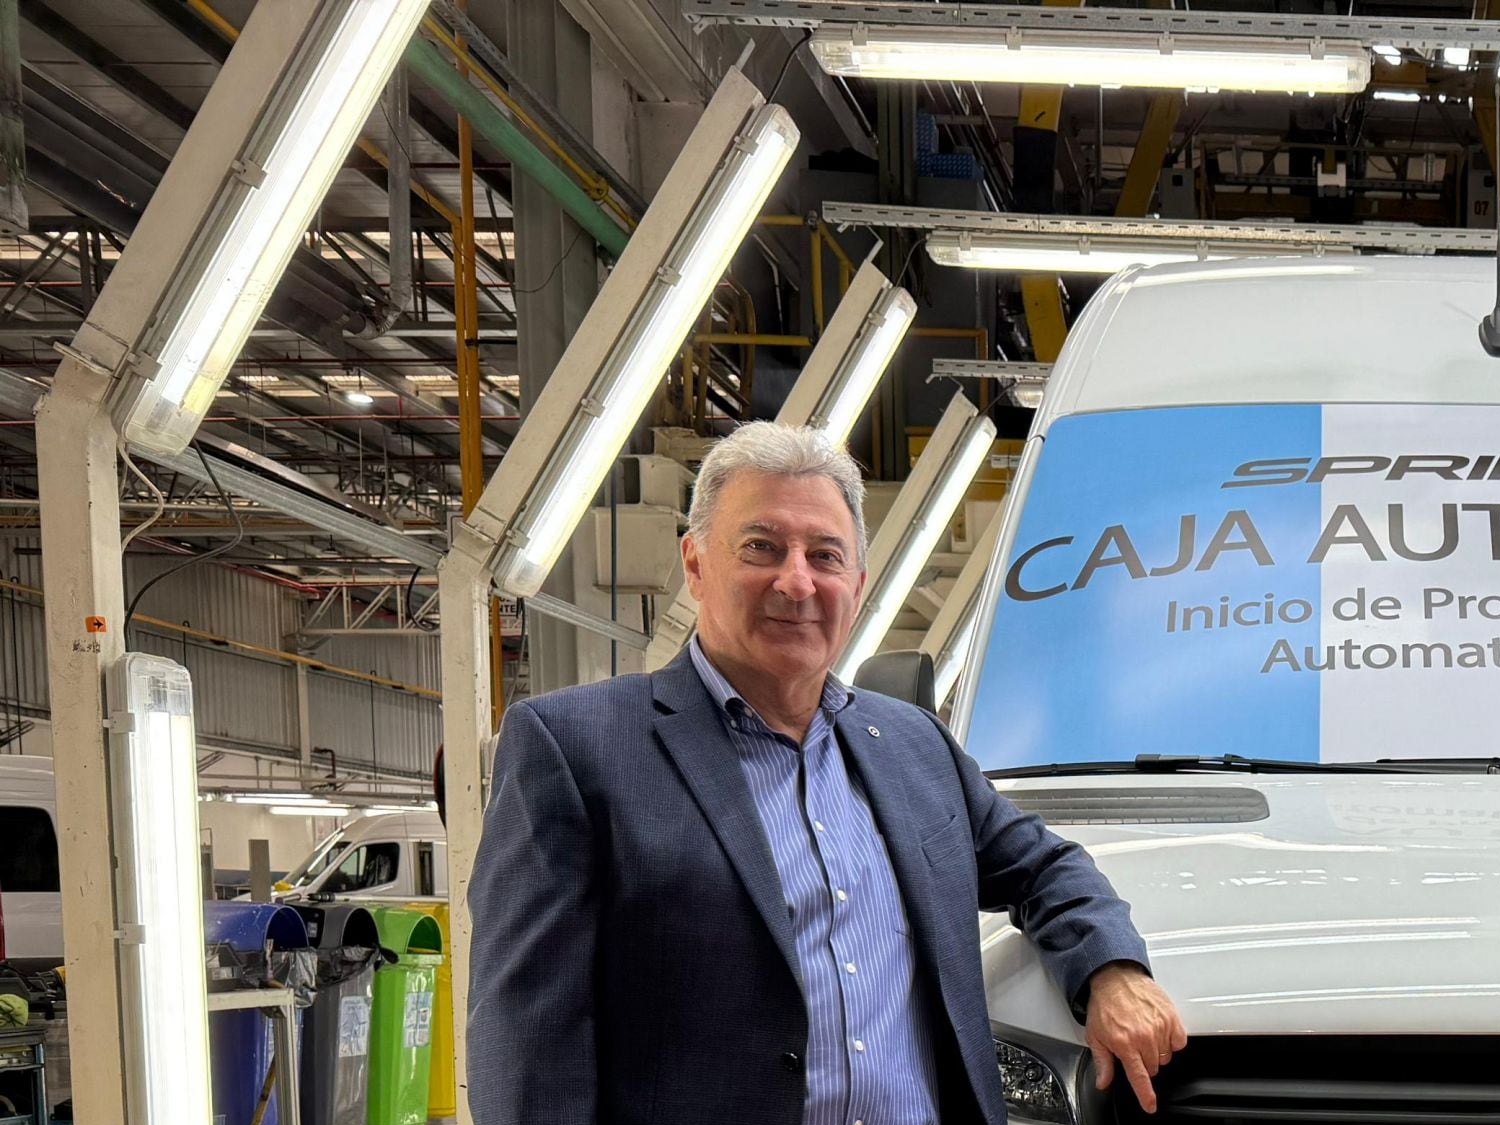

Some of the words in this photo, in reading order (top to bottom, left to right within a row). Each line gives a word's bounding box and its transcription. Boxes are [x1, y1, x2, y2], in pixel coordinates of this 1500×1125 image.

[1474, 200, 1489, 216] 07
[1004, 509, 1275, 602] CAJA
[1166, 592, 1313, 633] Inicio
[1332, 587, 1402, 621] de
